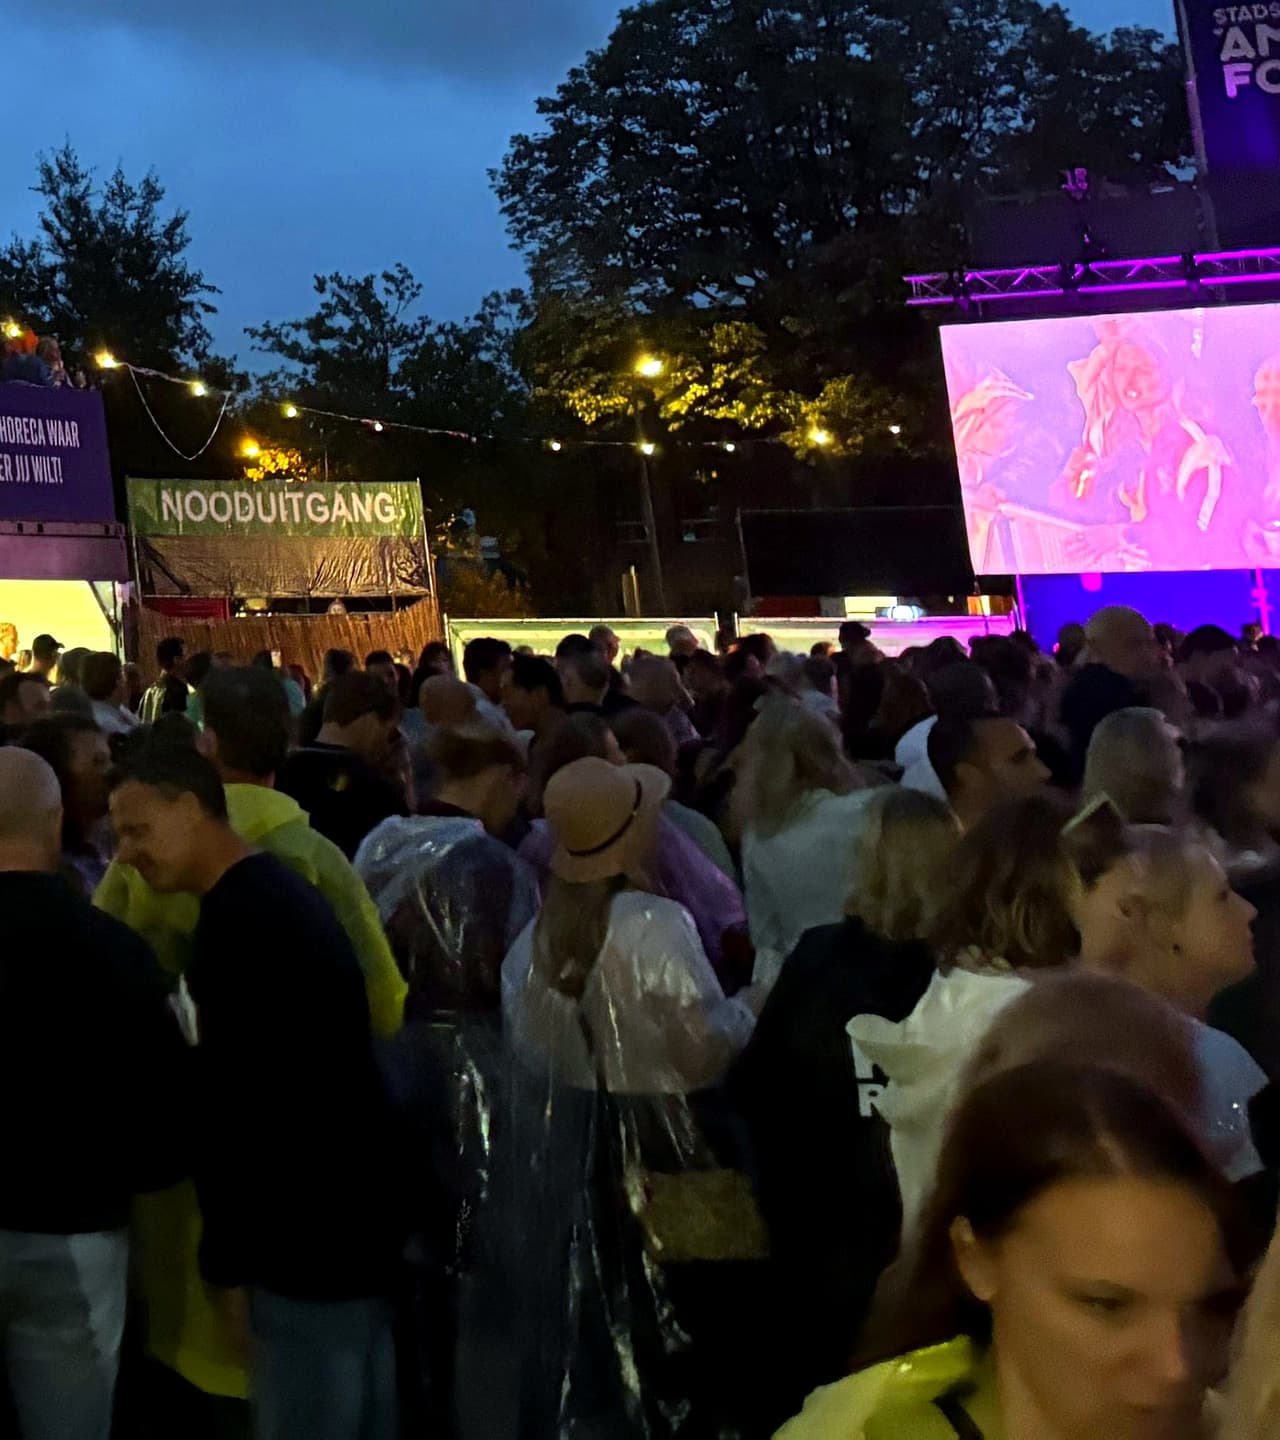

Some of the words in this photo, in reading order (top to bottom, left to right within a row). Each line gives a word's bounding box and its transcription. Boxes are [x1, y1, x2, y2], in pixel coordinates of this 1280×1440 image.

[46, 419, 80, 448] WAAR
[15, 453, 30, 483] JIJ
[31, 455, 64, 484] WILT!
[160, 489, 395, 524] NOODUITGANG
